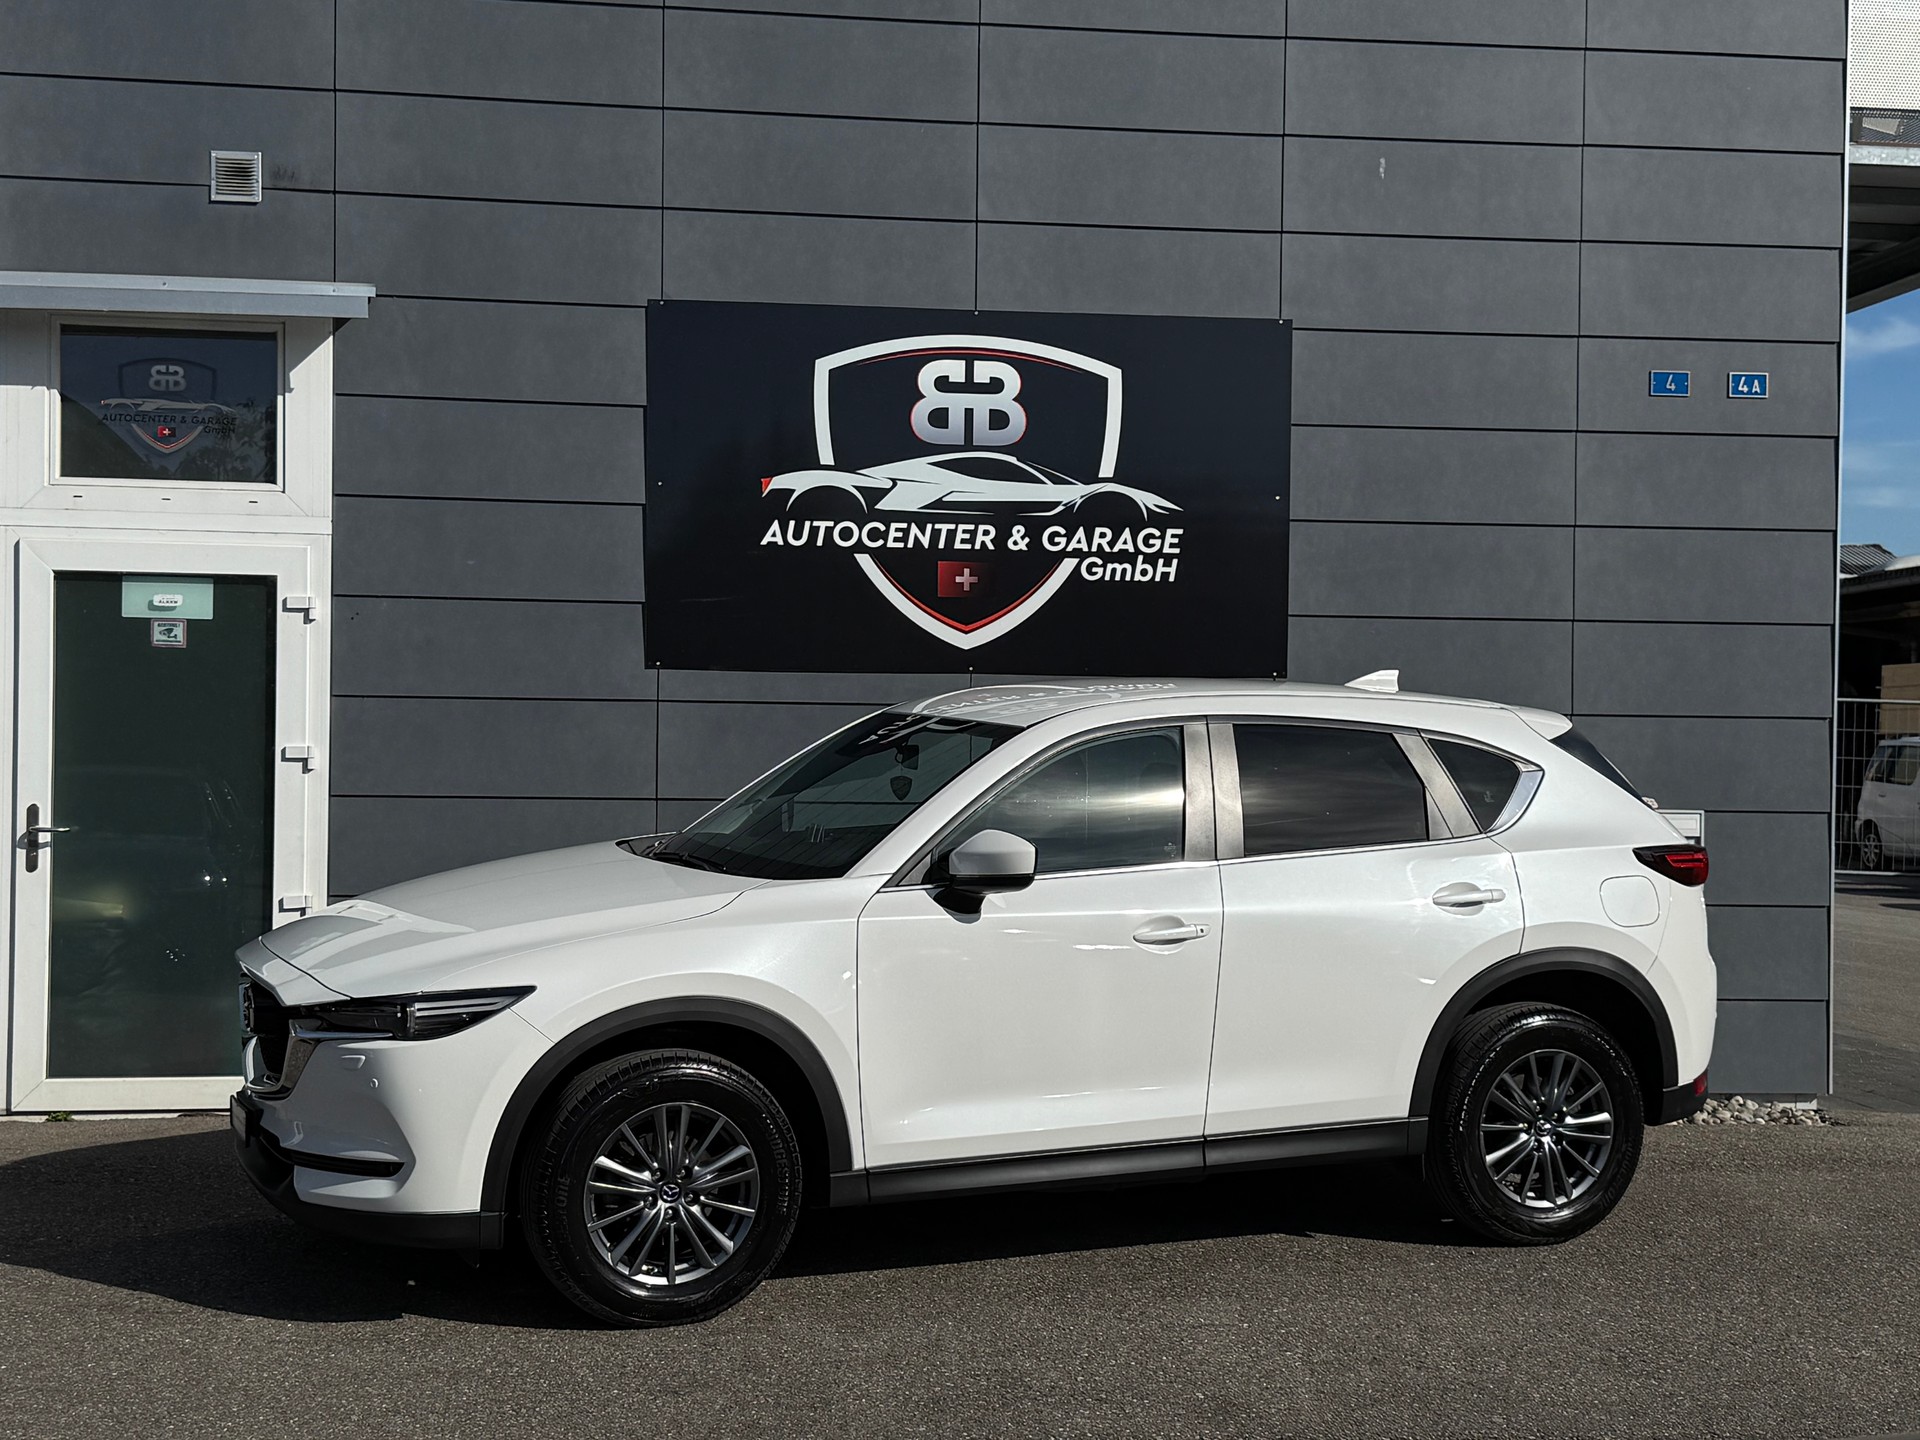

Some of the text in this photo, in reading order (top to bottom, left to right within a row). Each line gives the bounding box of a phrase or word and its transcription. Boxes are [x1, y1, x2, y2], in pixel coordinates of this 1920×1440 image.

[1665, 374, 1676, 391] 4
[102, 413, 238, 426] AUTOCENTER & GARAGE
[203, 425, 236, 435] GmbH
[760, 519, 1185, 554] AUTOCENTER & GARAGE
[1079, 555, 1179, 583] GmbH
